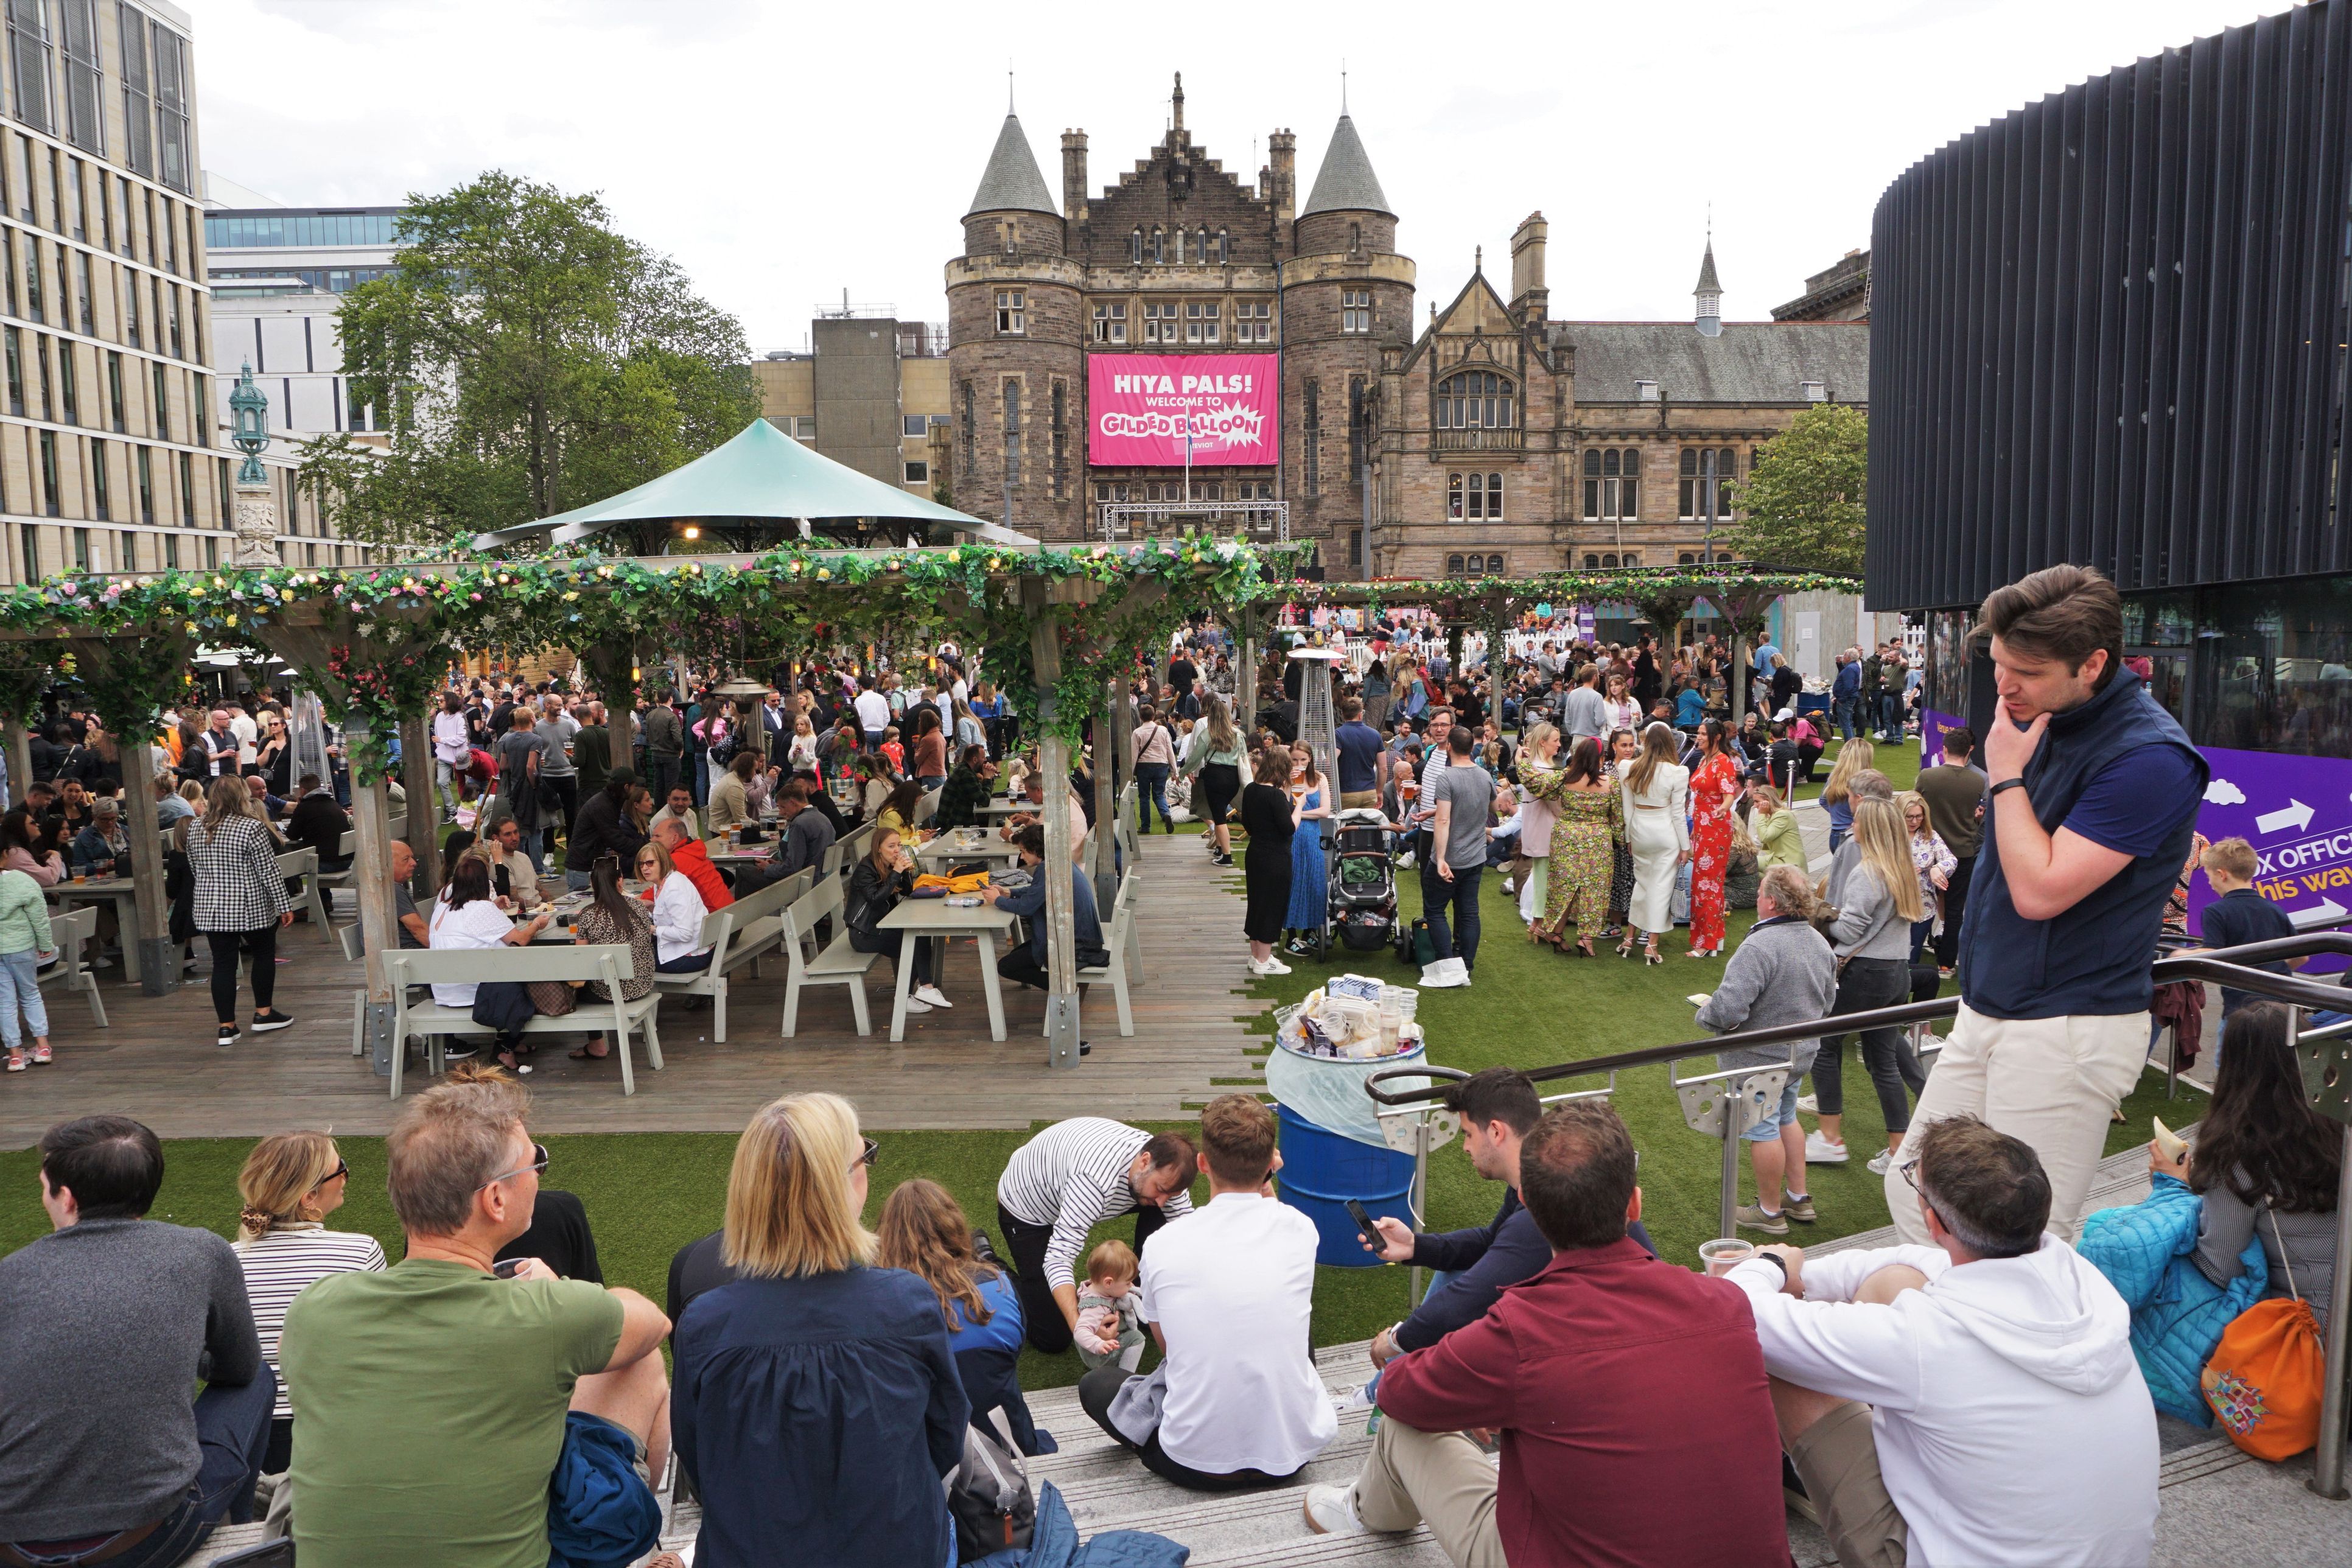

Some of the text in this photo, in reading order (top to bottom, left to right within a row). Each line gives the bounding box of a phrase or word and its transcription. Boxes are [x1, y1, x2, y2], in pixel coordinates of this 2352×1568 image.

[1114, 374, 1252, 394] HIYA PALS!
[1146, 396, 1222, 407] WELCOME TO
[1102, 414, 1258, 435] GILDED BALLOON
[2278, 832, 2352, 868] OFFIC
